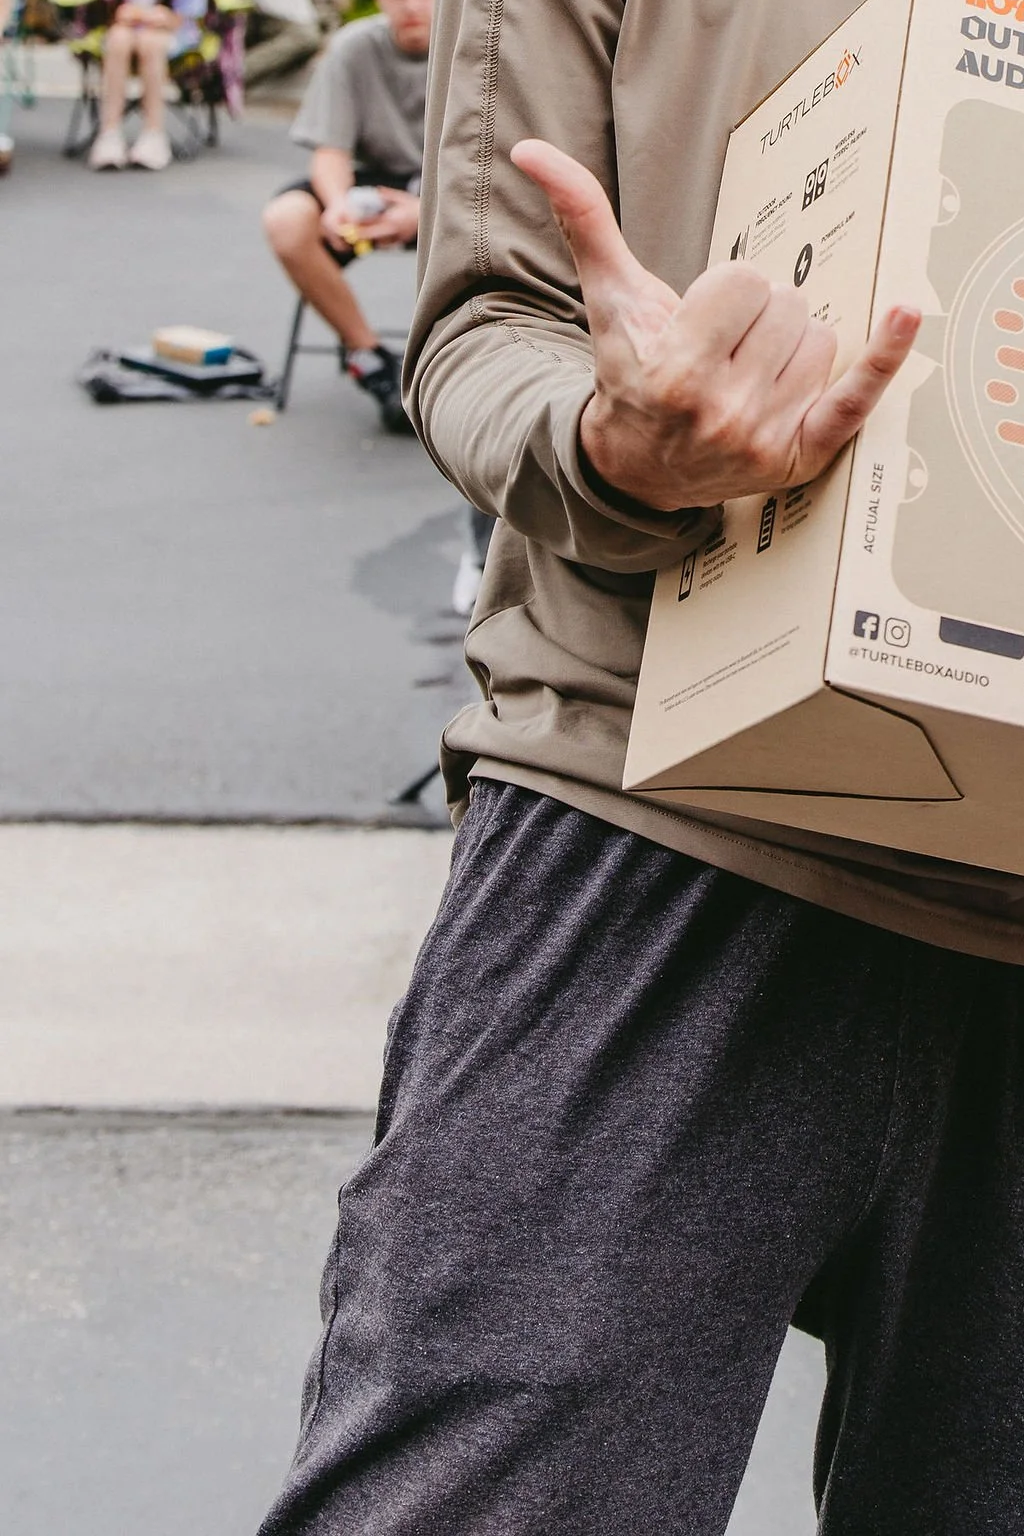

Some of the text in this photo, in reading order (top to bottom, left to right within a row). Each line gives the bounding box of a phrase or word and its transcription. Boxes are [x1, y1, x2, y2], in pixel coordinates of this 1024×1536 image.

[760, 45, 862, 155] TURTLEBOX
[863, 462, 885, 554] ACTUAL SIZE
[848, 647, 990, 687] @TURTLEBOXAUDIO
